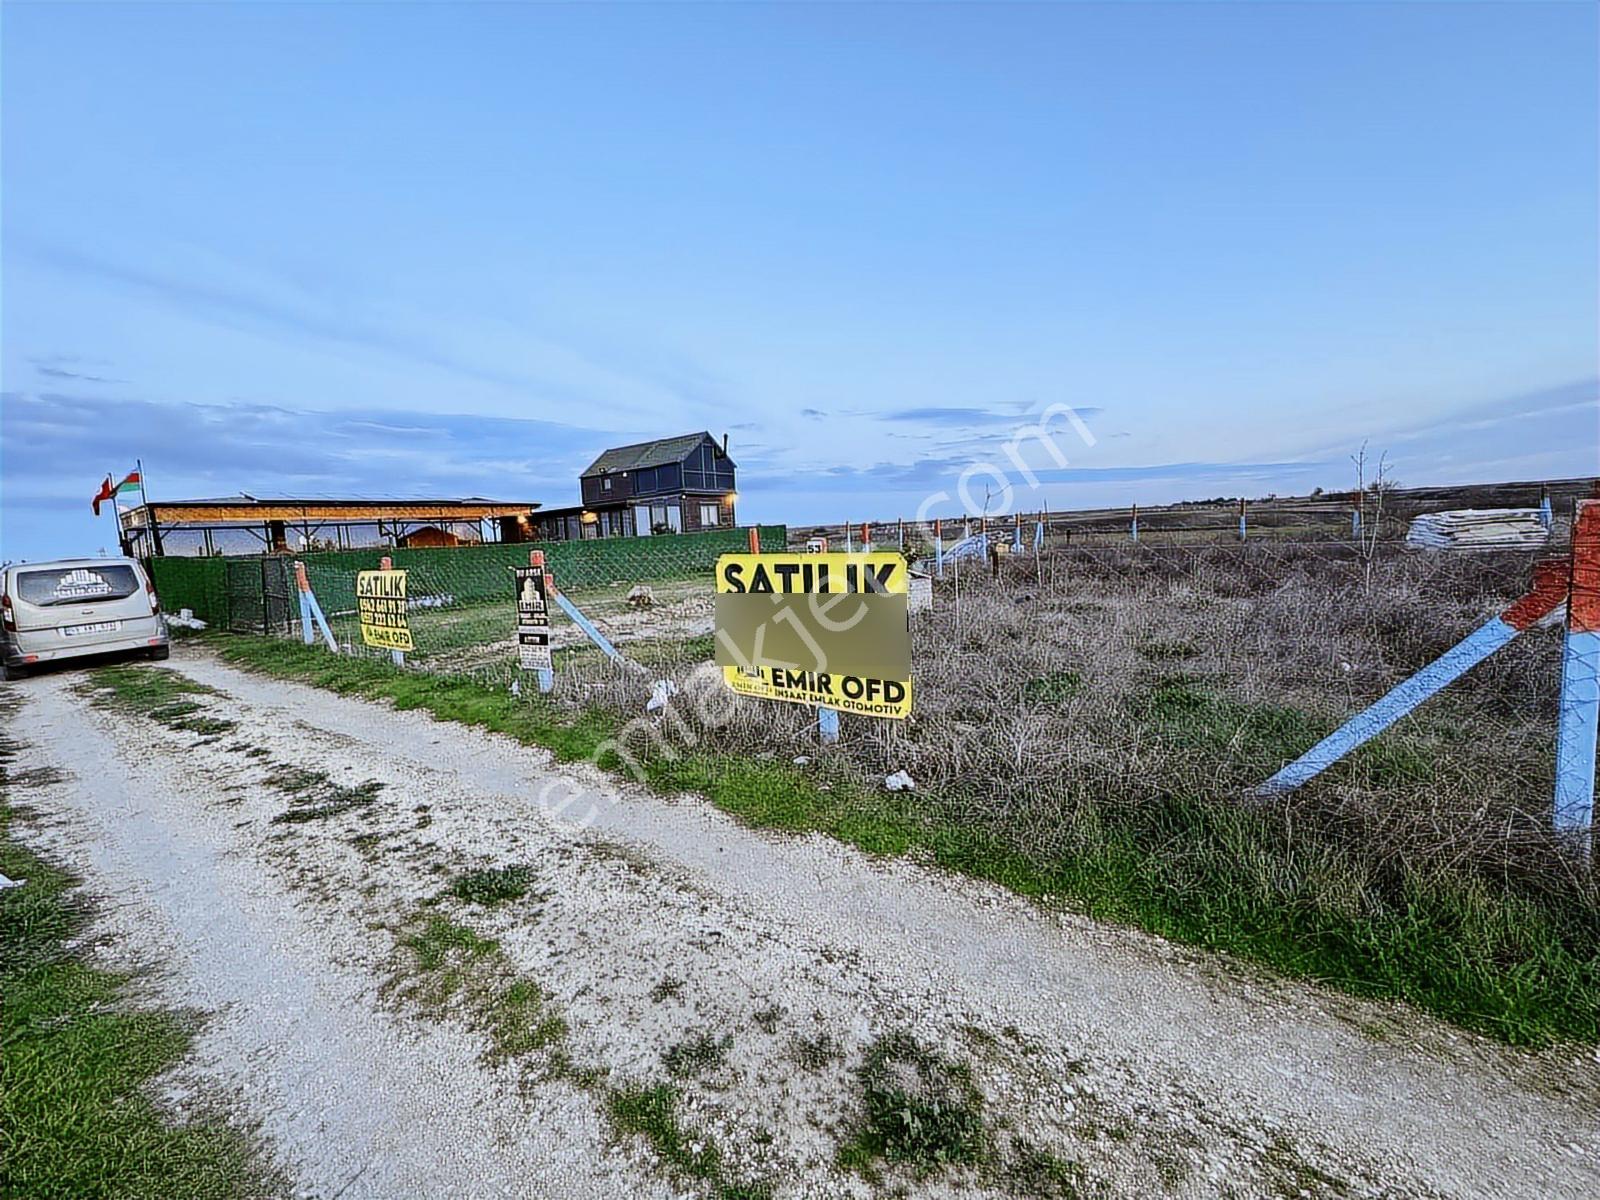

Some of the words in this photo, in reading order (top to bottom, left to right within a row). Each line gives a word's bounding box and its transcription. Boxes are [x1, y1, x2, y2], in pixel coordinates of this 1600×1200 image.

[359, 575, 404, 597] SATILIK
[809, 693, 840, 707] EMLAK
[841, 675, 906, 703] OFD
